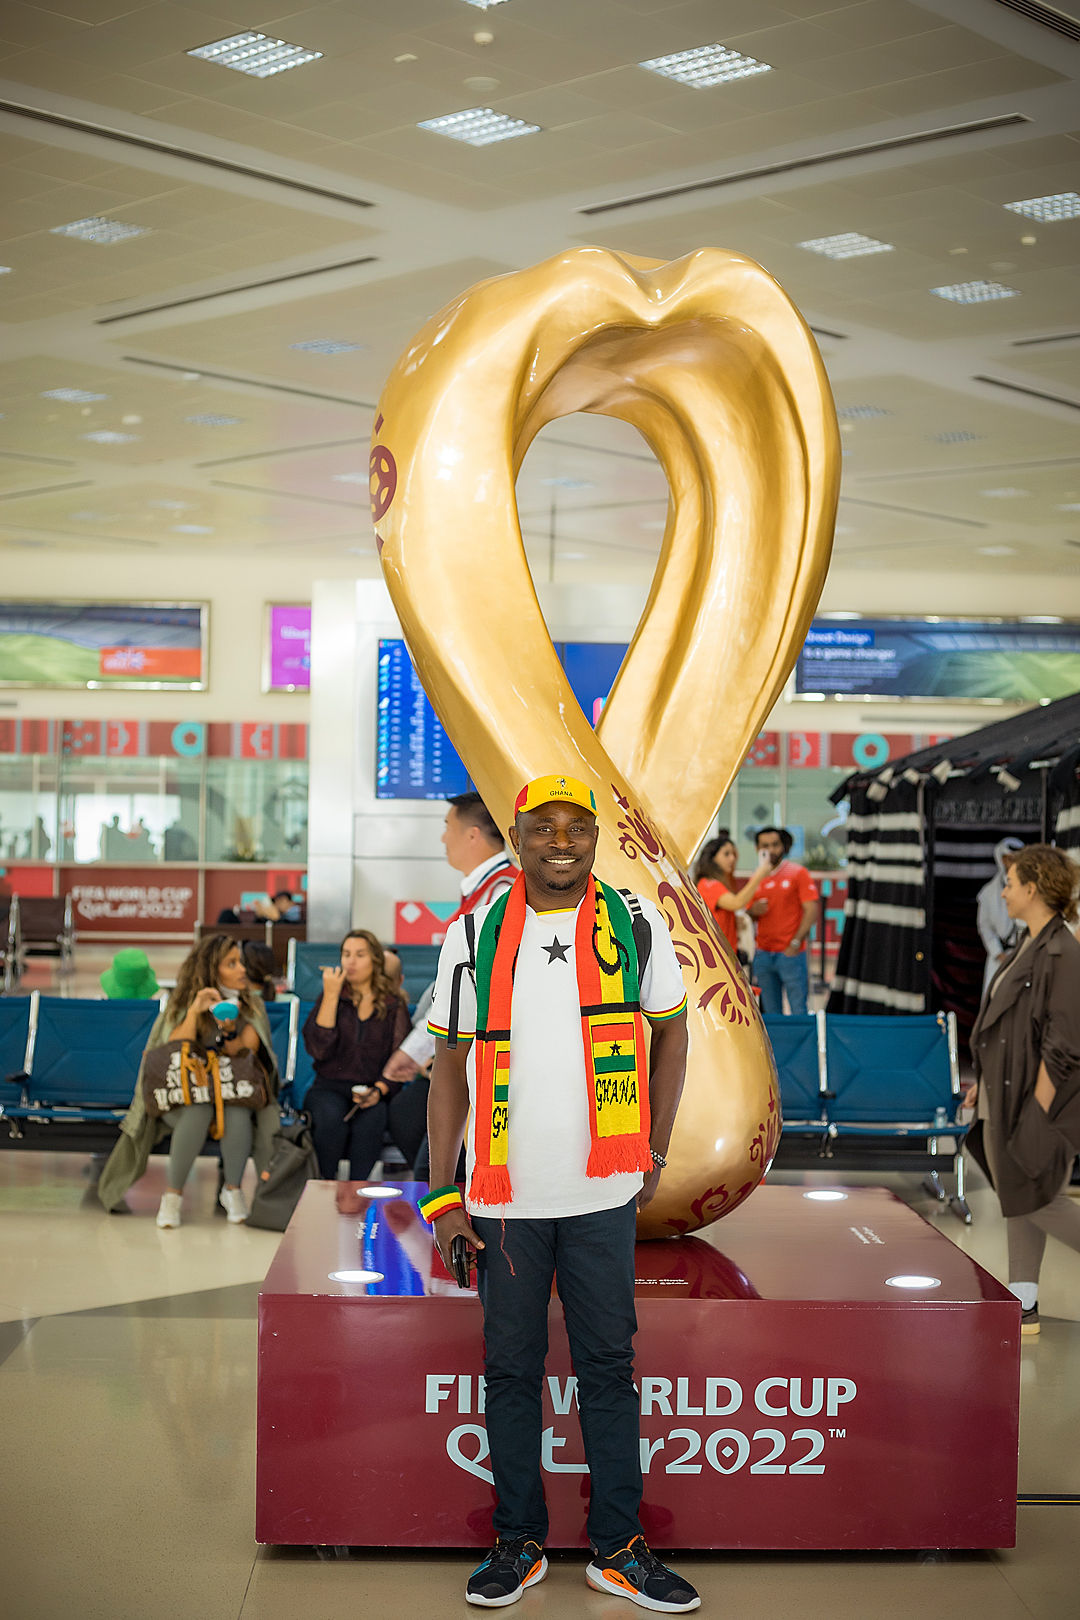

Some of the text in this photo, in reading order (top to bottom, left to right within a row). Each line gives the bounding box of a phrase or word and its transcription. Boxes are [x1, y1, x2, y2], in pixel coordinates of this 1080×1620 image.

[72, 885, 193, 902] FIFA WORLD CUP
[596, 1075, 637, 1112] GHANA
[425, 1374, 857, 1417] FI WRLD CUP
